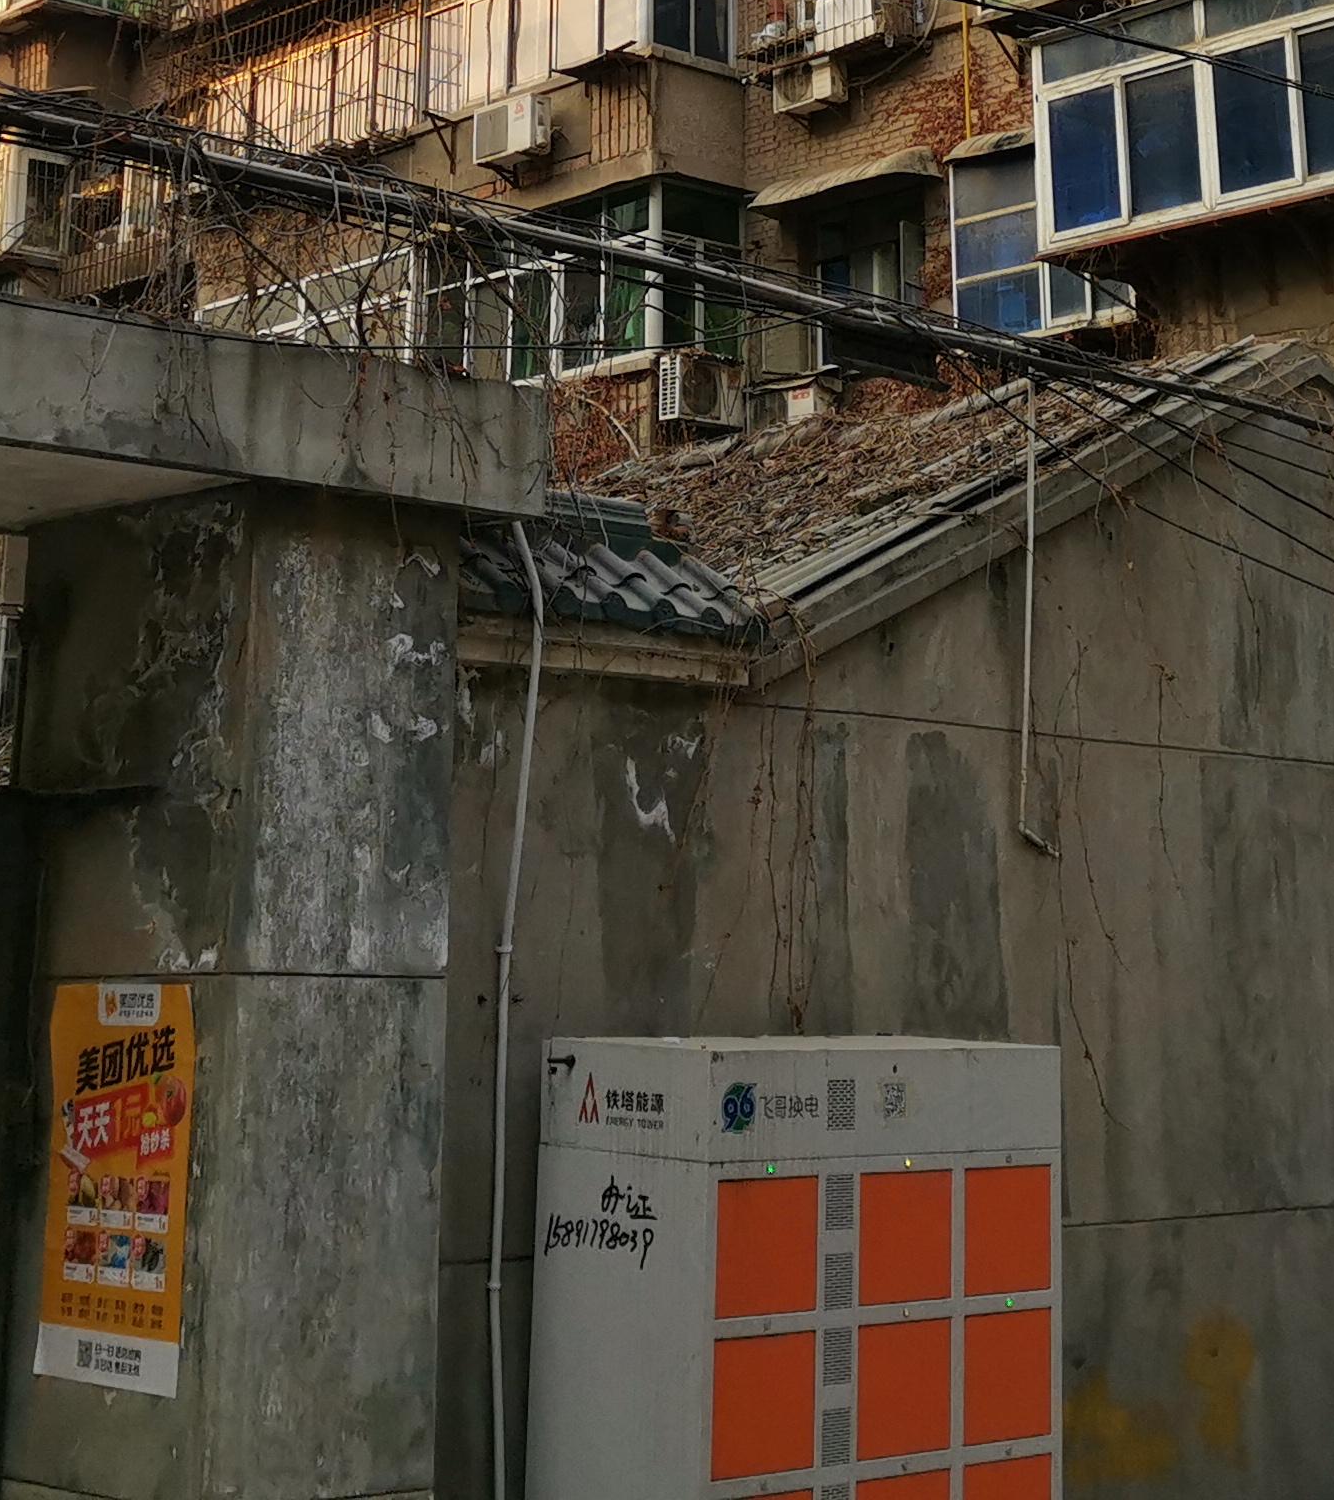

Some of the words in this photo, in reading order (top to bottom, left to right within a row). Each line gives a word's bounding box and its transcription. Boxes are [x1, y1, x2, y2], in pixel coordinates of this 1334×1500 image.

[75, 1024, 176, 1095] 美团优选
[605, 1088, 666, 1116] 铁塔能源
